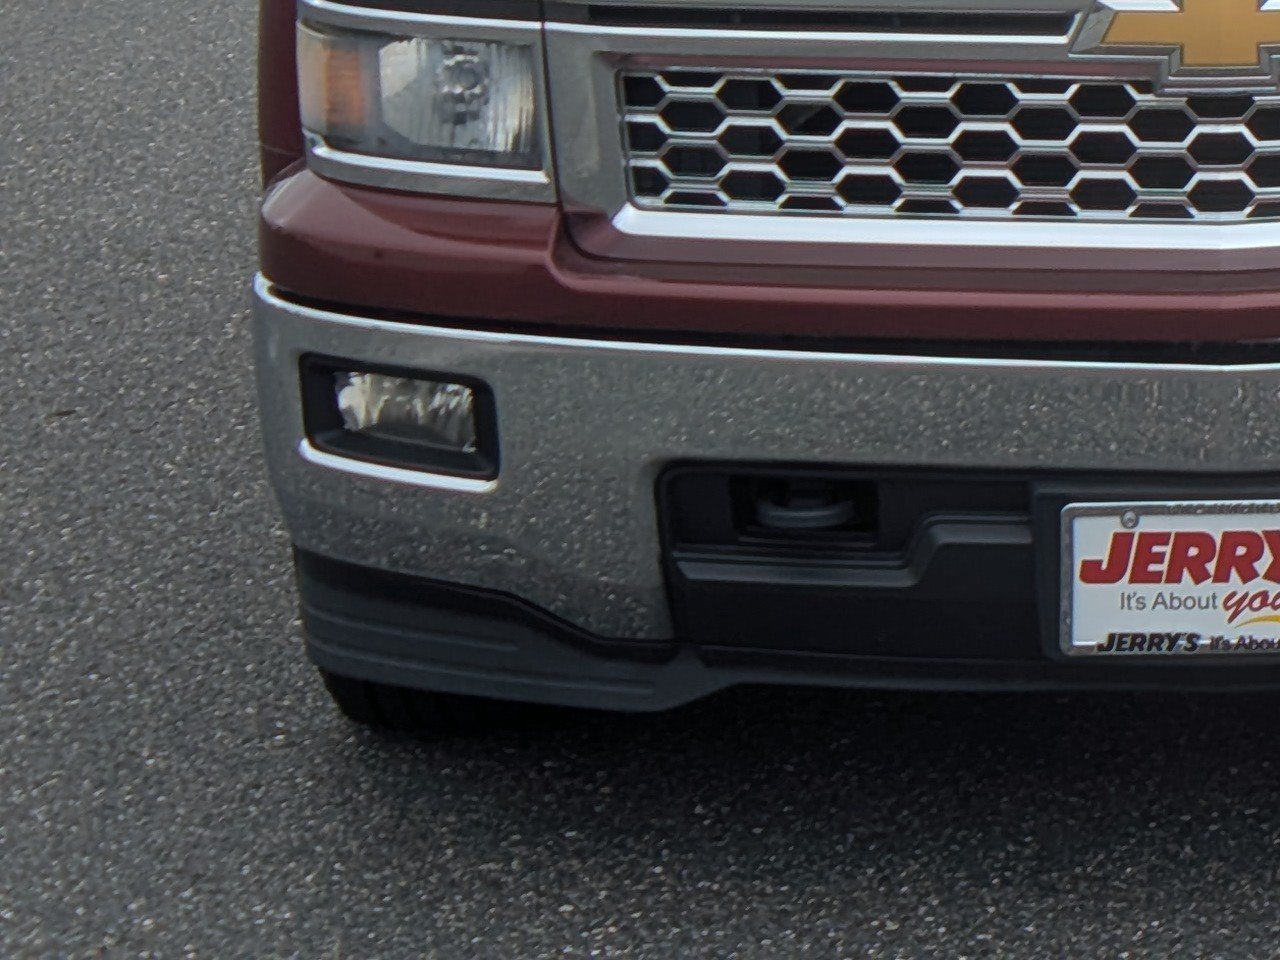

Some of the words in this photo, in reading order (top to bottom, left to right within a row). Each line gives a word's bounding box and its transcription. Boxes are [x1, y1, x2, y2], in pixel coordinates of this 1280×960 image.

[1120, 592, 1147, 610] It's
[1152, 592, 1218, 610] About
[1096, 632, 1201, 652] JERRY'S
[1210, 635, 1231, 651] It's
